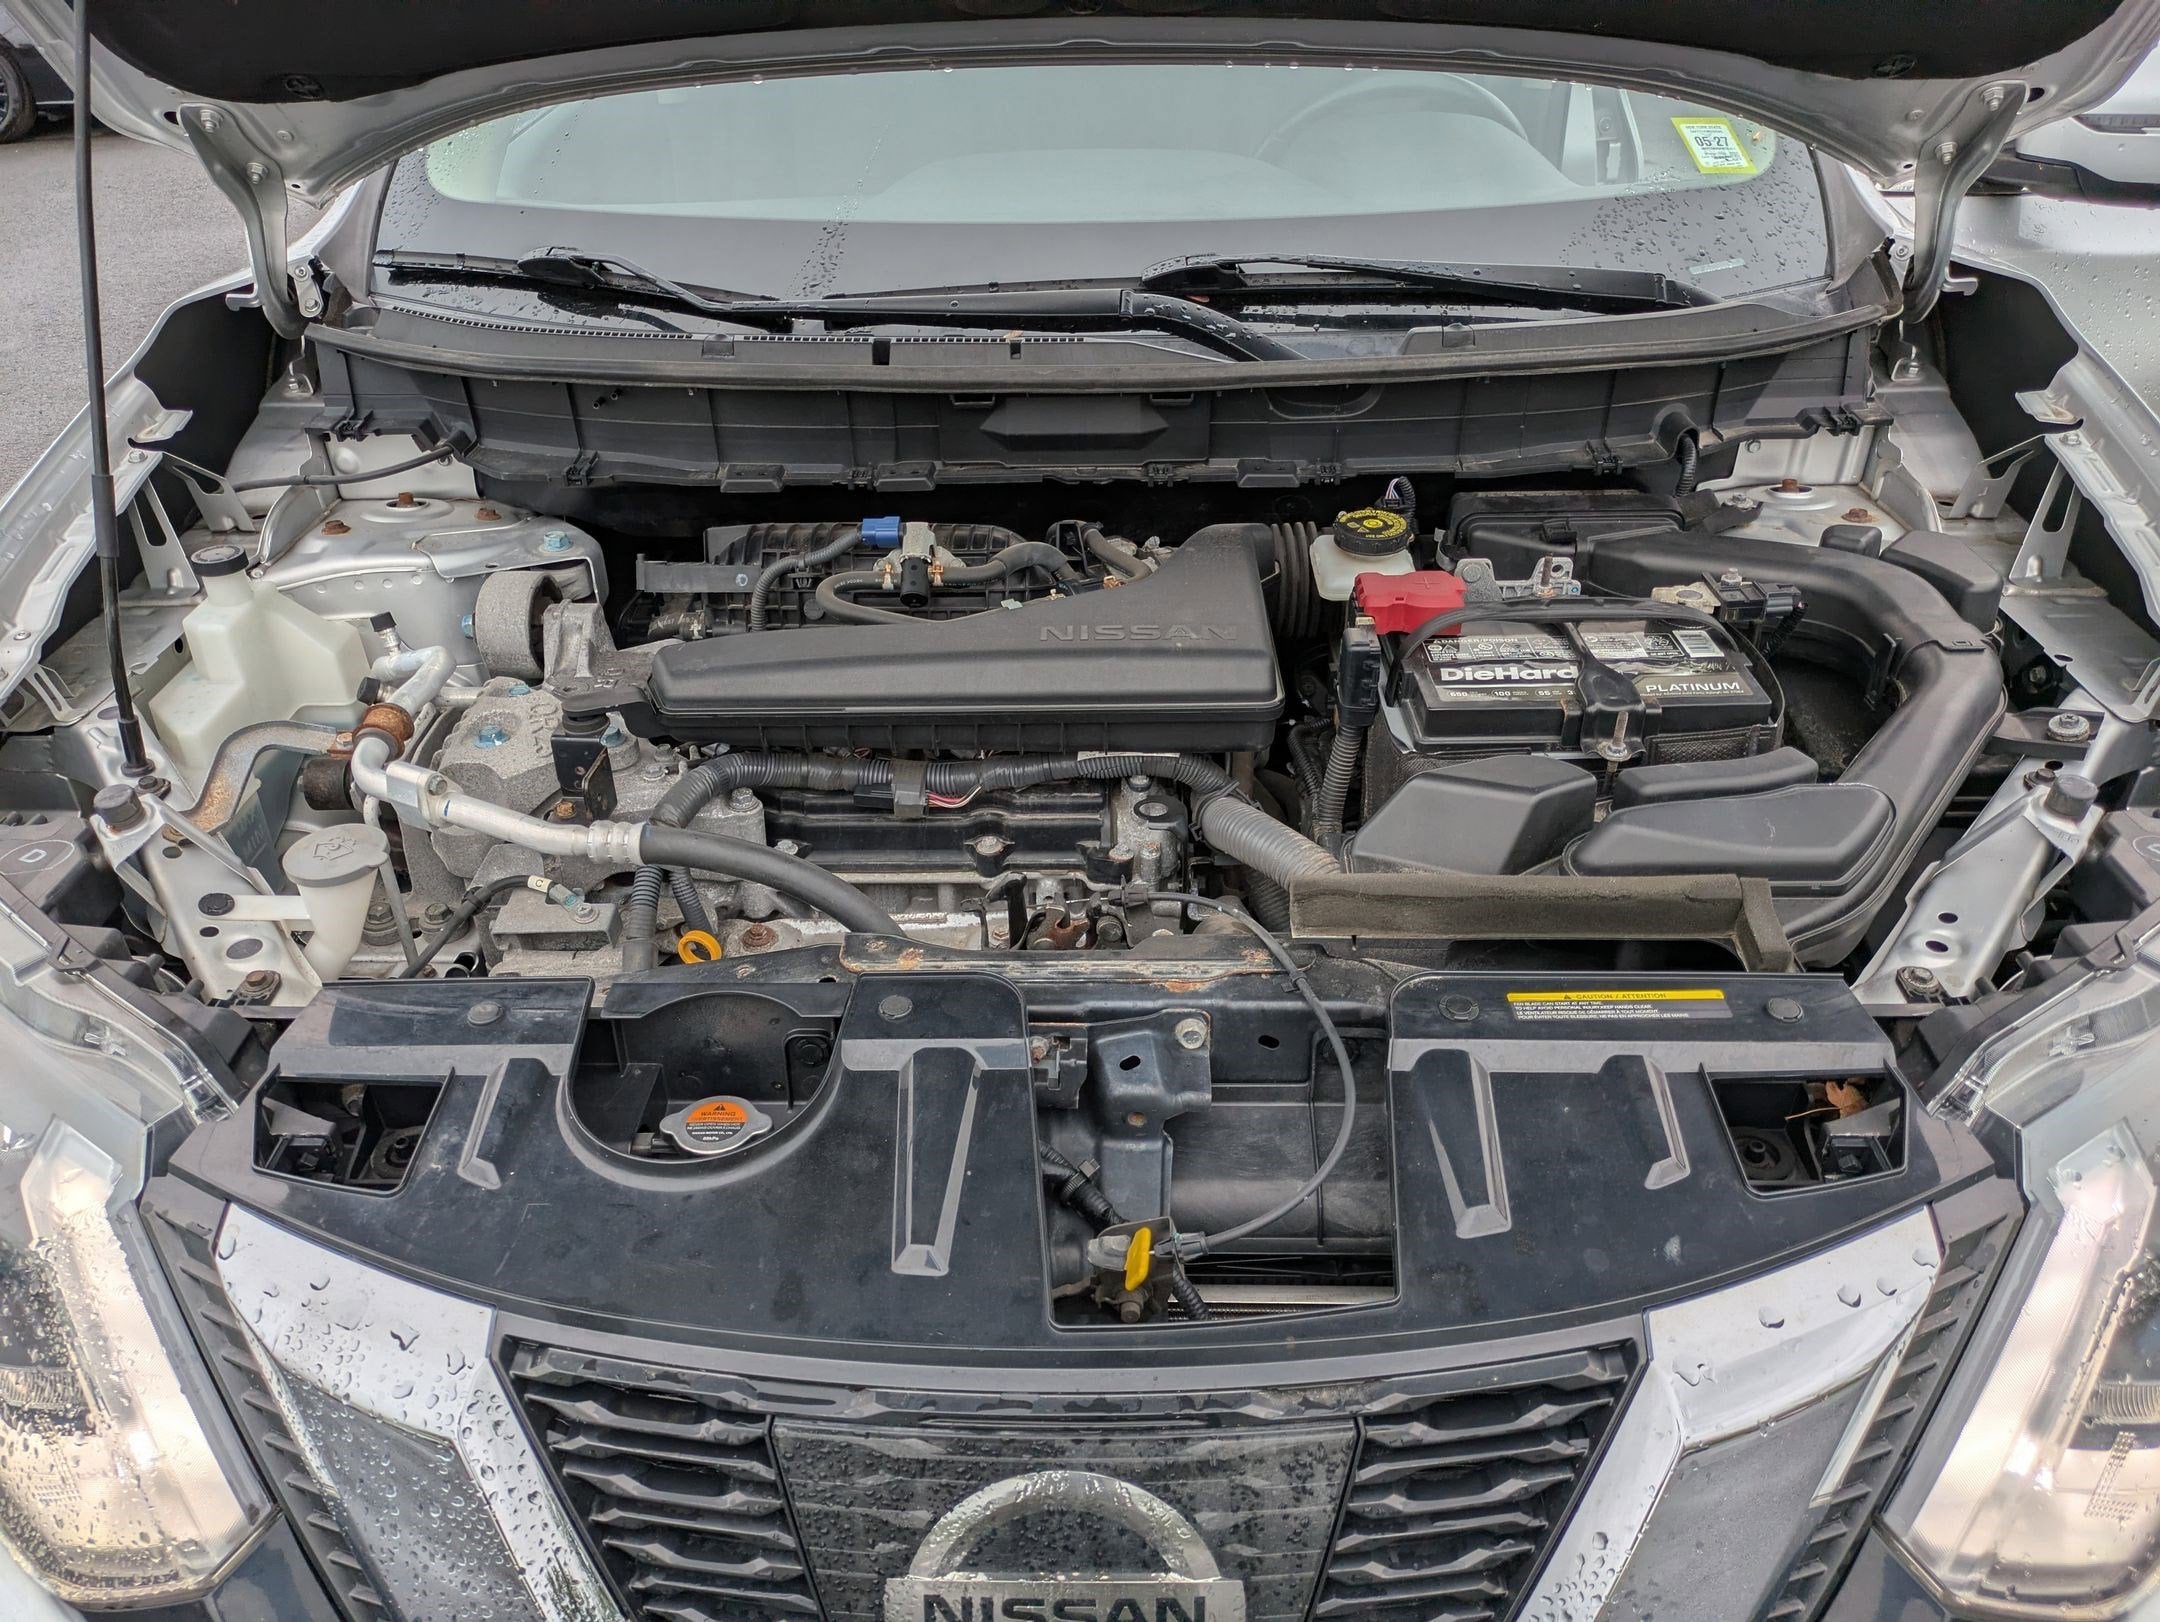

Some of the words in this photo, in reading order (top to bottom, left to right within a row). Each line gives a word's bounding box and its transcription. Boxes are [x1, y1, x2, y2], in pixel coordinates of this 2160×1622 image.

[1039, 624, 1238, 642] NISSAN
[1440, 666, 1579, 682] DieHard
[1645, 682, 1741, 693] PLATINUM
[18, 848, 48, 863] D
[535, 879, 544, 888] C
[923, 1594, 1206, 1622] NISSAN
